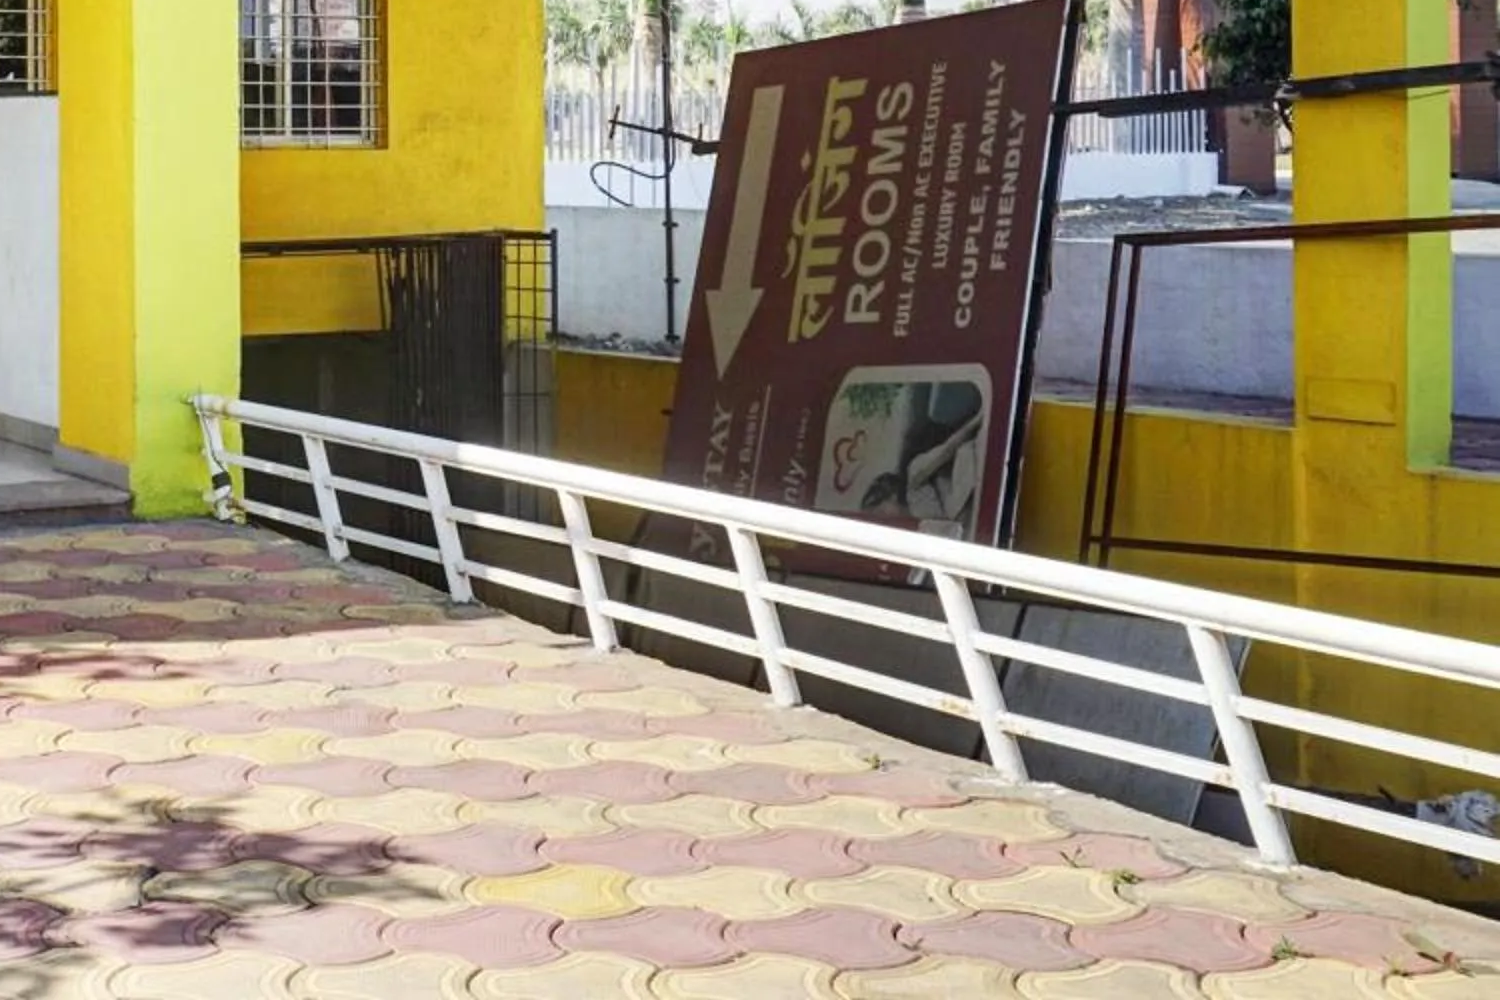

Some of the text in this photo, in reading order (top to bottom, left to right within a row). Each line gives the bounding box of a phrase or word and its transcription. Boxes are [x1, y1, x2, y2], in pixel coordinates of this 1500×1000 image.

[918, 60, 948, 168] EXECUTIVE
[843, 81, 914, 323] ROOMS
[914, 171, 932, 198] AC
[932, 121, 967, 269] LUXURY ROOM
[954, 59, 1006, 329] COUPLE, FAMILY
[989, 108, 1027, 271] FRIENDLY
[893, 291, 915, 337] FULL
[782, 458, 808, 503] nly
